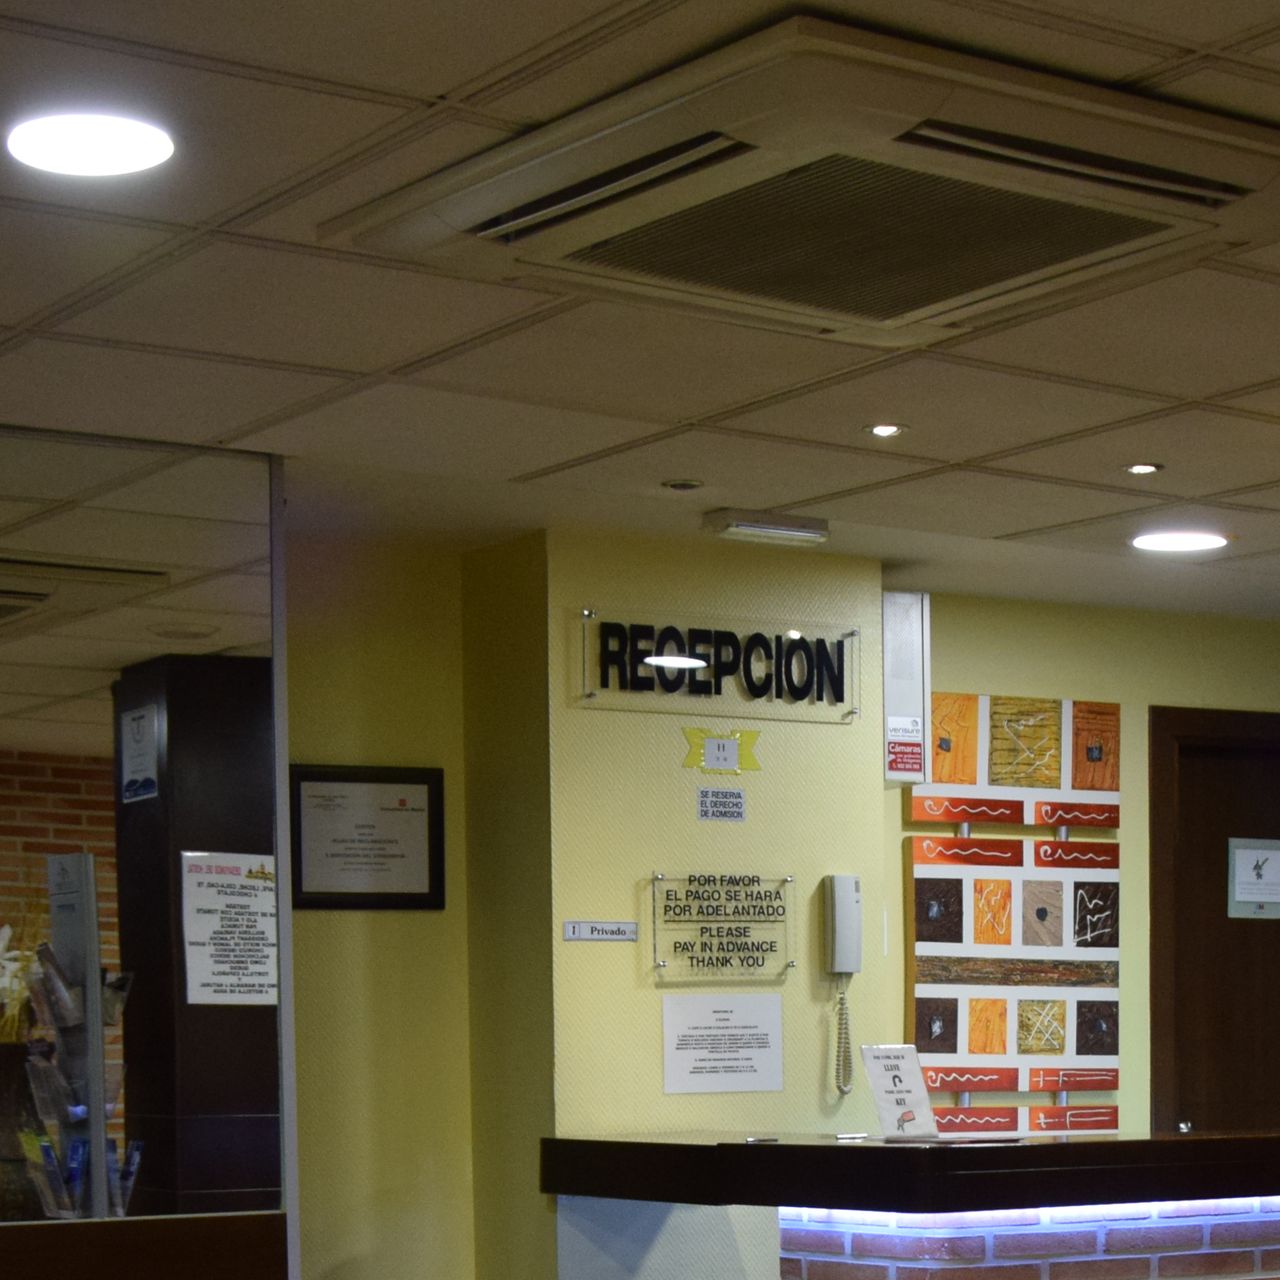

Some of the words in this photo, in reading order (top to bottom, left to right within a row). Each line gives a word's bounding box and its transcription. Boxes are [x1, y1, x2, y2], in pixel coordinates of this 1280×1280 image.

[700, 790, 710, 799] SE
[711, 790, 742, 799] RESERVA
[700, 800, 708, 808] EL
[710, 800, 743, 809] DERECHO
[700, 809, 710, 818] DE
[688, 875, 717, 886] POR
[720, 875, 761, 887] FAVOR
[666, 890, 681, 901] EL
[685, 890, 721, 901] PAGO
[725, 890, 741, 901] SE
[745, 890, 783, 902] HARA
[663, 904, 692, 917] POR
[696, 905, 786, 917] ADELANTADO
[590, 926, 627, 936] Privado
[700, 926, 751, 938] PLEASE
[673, 941, 696, 953] PAY
[701, 941, 713, 953] IN
[718, 941, 777, 953] ADVANCE
[688, 956, 733, 968] THANK
[739, 956, 765, 968] YOU
